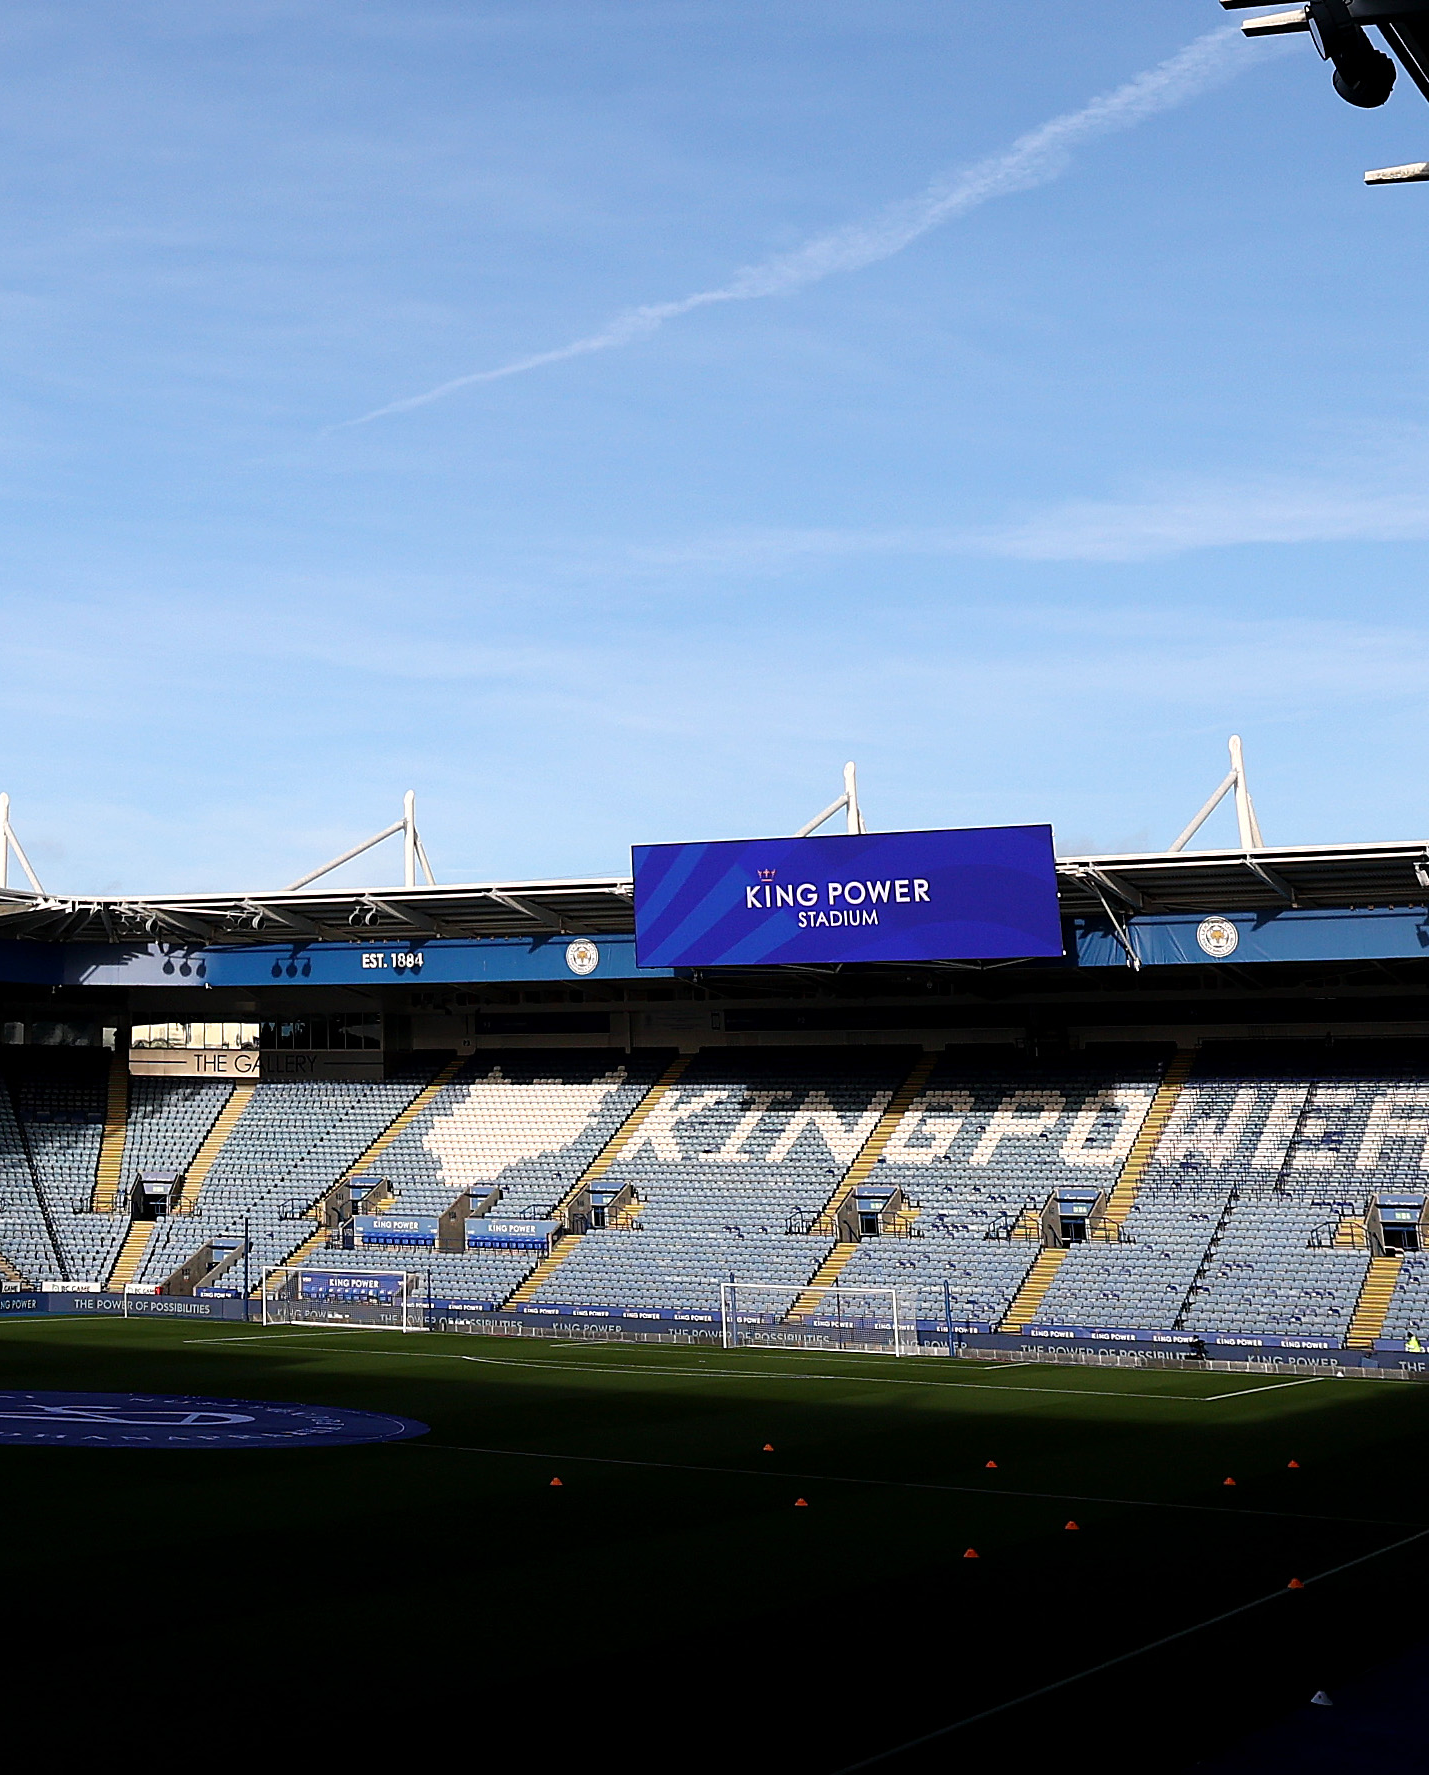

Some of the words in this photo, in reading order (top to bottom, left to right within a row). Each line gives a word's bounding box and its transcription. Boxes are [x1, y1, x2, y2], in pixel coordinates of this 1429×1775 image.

[745, 882, 819, 909] KING
[827, 878, 931, 907] POWER
[797, 908, 879, 929] STADIUM
[361, 952, 388, 969] EST.
[390, 952, 424, 969] 1884
[194, 1054, 228, 1072] THE
[233, 1054, 317, 1073] GALLERY
[372, 1220, 391, 1229] KING
[392, 1220, 419, 1230] POWER
[487, 1224, 507, 1233] KING
[508, 1224, 536, 1234] POWER
[329, 1278, 350, 1288] KING
[351, 1279, 379, 1289] POWER
[11, 1298, 37, 1310] POWER
[74, 1298, 94, 1310] THE
[96, 1299, 133, 1312] POWER
[135, 1300, 149, 1312] OF
[150, 1302, 211, 1315] POSSIBILITIES
[1398, 1361, 1427, 1374] THE
